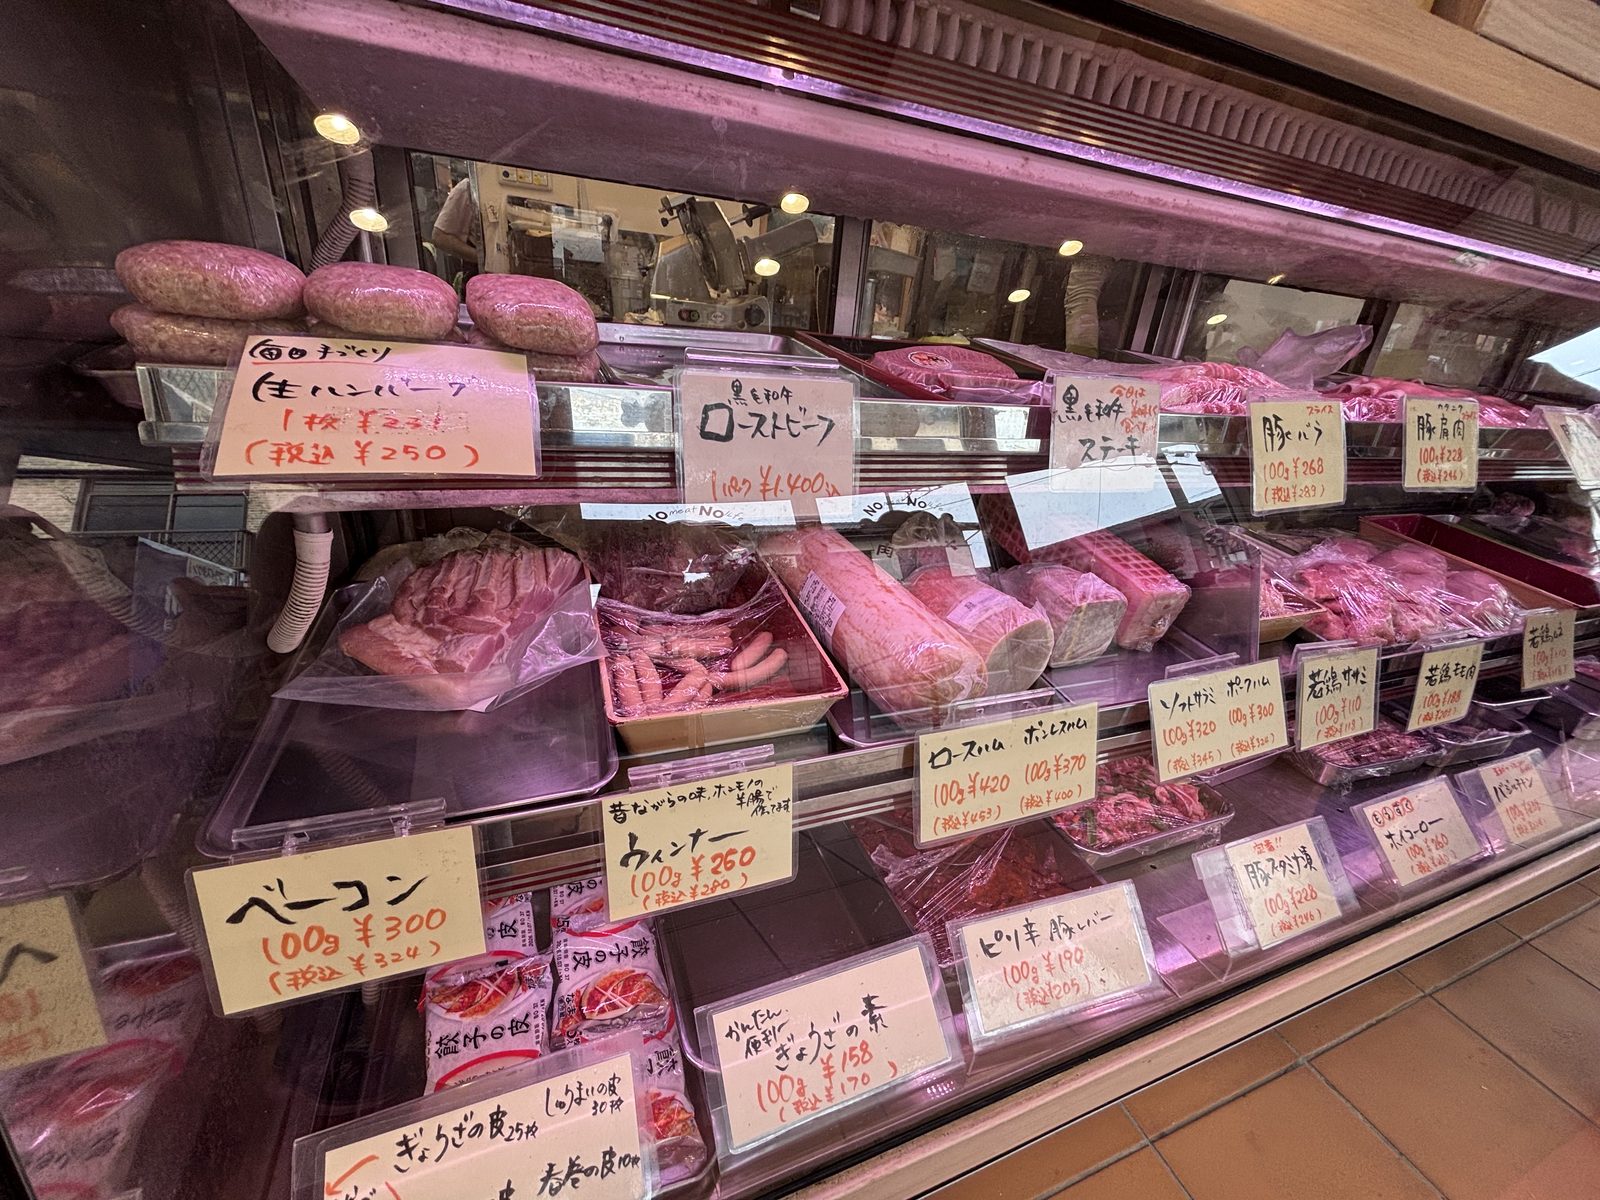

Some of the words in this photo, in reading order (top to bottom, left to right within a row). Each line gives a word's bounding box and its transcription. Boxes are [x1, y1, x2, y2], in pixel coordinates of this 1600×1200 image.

[697, 402, 836, 447] ローストビーフ
[1263, 413, 1323, 453] 豚バラ
[1417, 413, 1465, 441] 豚肩肉
[1078, 435, 1141, 462] ステーキ
[1023, 717, 1088, 746] ボンレスハム
[928, 738, 1005, 770] ロースハム
[619, 828, 751, 871] ウィンナー
[226, 875, 429, 926] ベーコン
[573, 937, 650, 971] 餃子の皮
[435, 1012, 530, 1059] 餃子の皮
[775, 993, 889, 1072] ぎょうざの素
